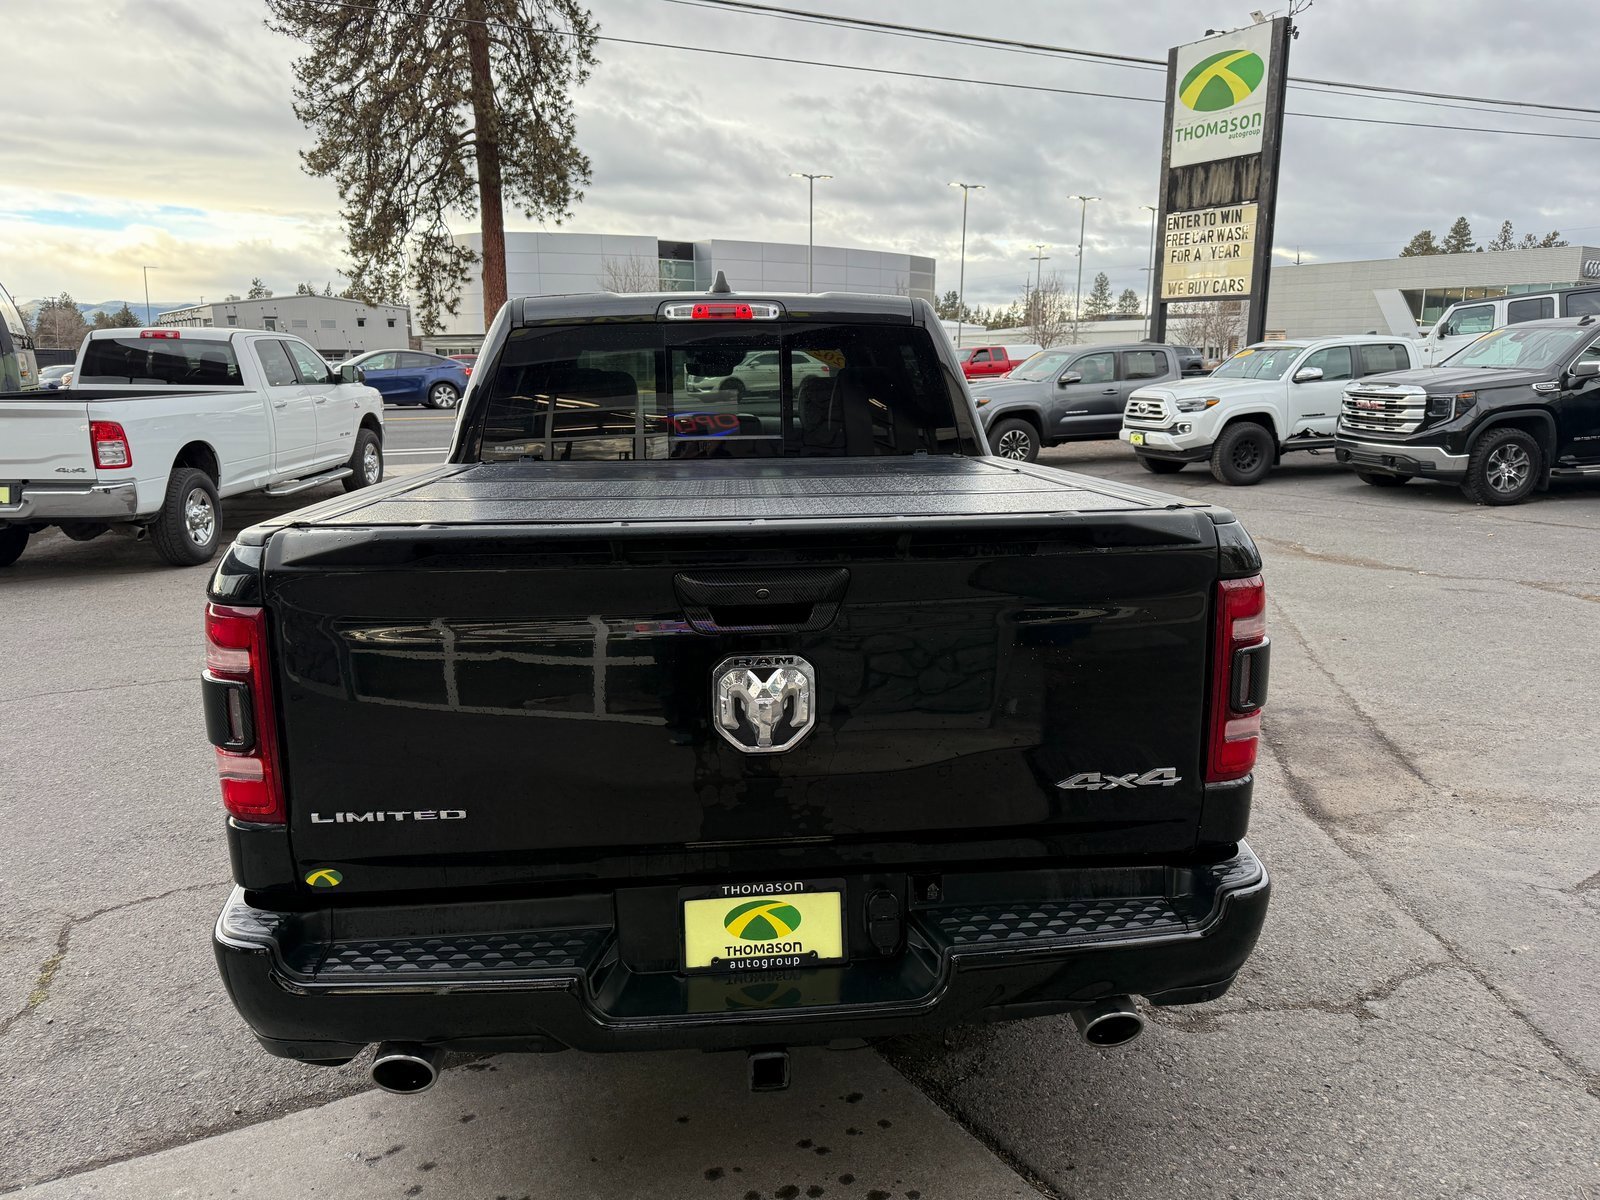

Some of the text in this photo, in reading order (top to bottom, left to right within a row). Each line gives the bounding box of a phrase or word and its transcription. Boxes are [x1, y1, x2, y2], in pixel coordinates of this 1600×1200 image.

[1228, 128, 1261, 140] autogroup
[1167, 208, 1243, 231] ENTER TO WIN
[1166, 225, 1249, 248] FREE CAR WASH
[1171, 244, 1241, 263] FOR A YEAR
[1168, 278, 1245, 296] WE BUY CARS
[733, 656, 795, 667] RAM
[310, 809, 468, 824] LIMITED
[729, 956, 801, 969] autogroup
